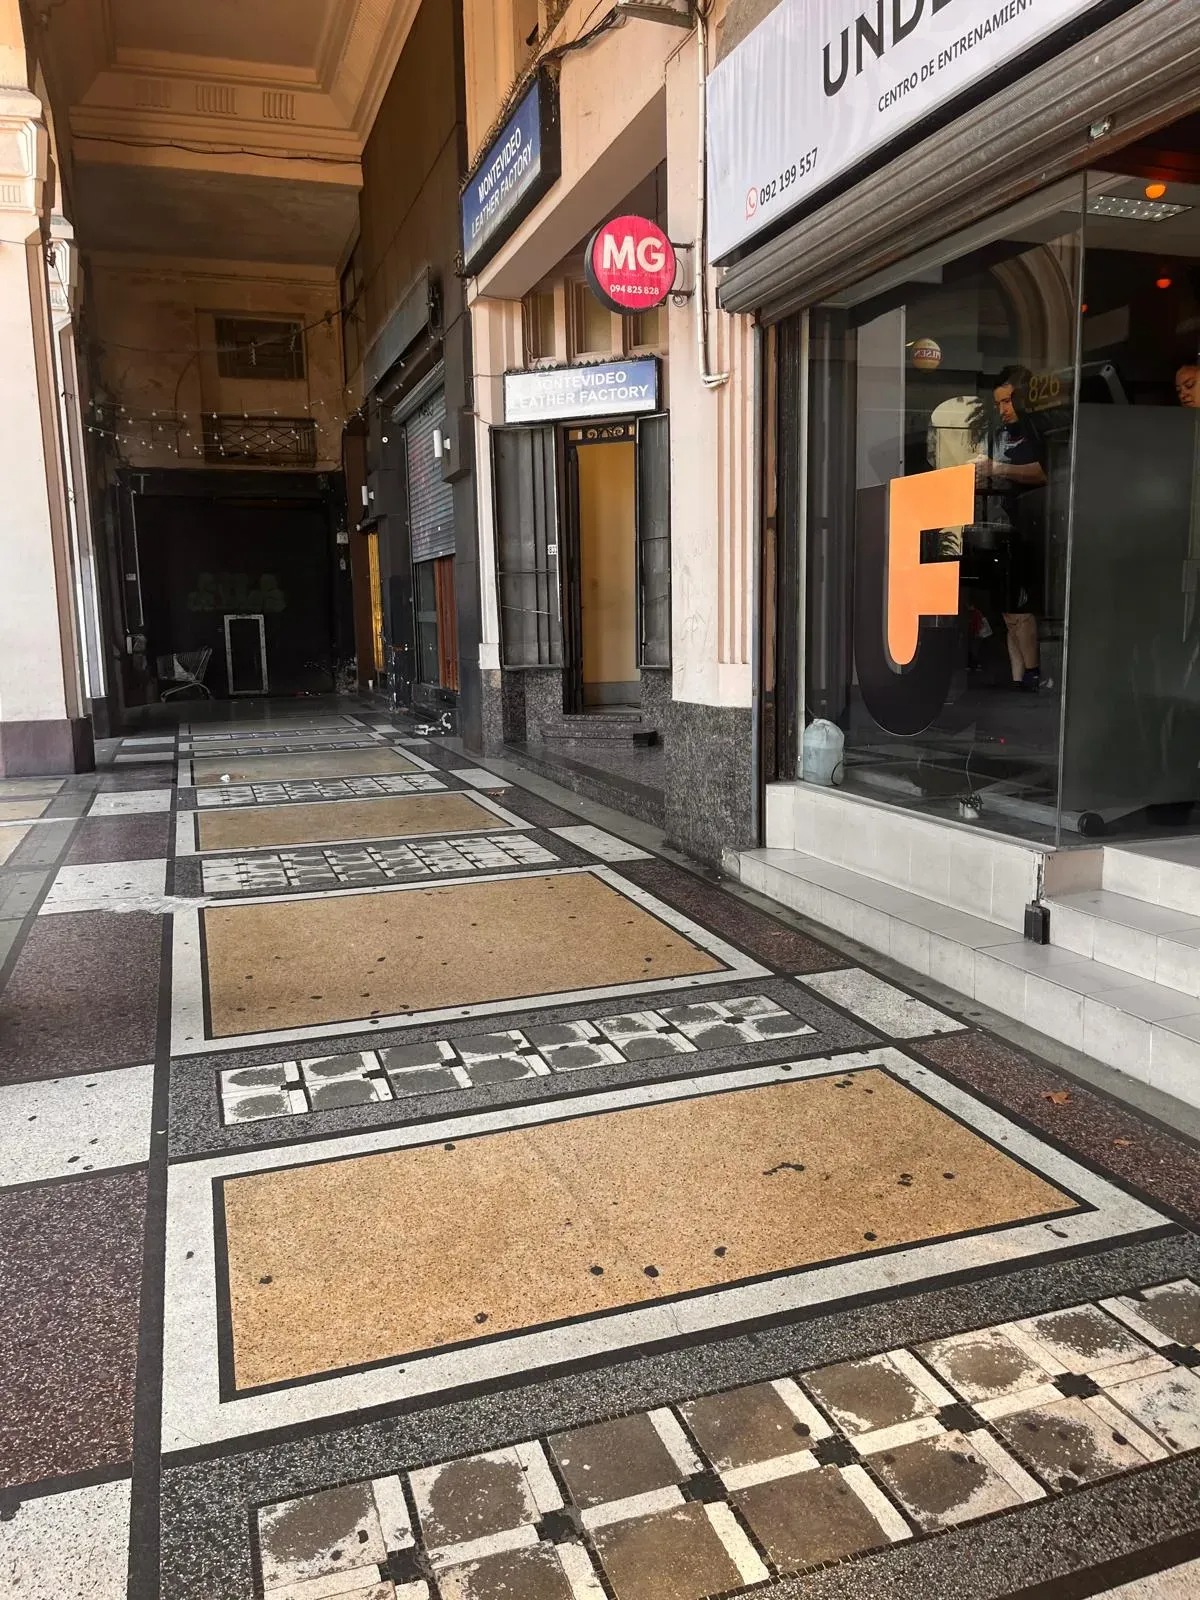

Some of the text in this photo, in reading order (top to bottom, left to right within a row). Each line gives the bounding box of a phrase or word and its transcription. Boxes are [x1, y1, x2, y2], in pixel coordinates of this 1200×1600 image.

[877, 72, 918, 113] CENTRO
[920, 58, 935, 83] DE
[471, 137, 533, 239] LEATHER FACTORY
[478, 127, 522, 204] MONTEVIDEO
[759, 146, 818, 206] 092 199 557
[602, 233, 666, 273] MG
[610, 284, 660, 296] 094 825 828
[579, 384, 649, 403] FACTORY
[1029, 375, 1060, 402] 826
